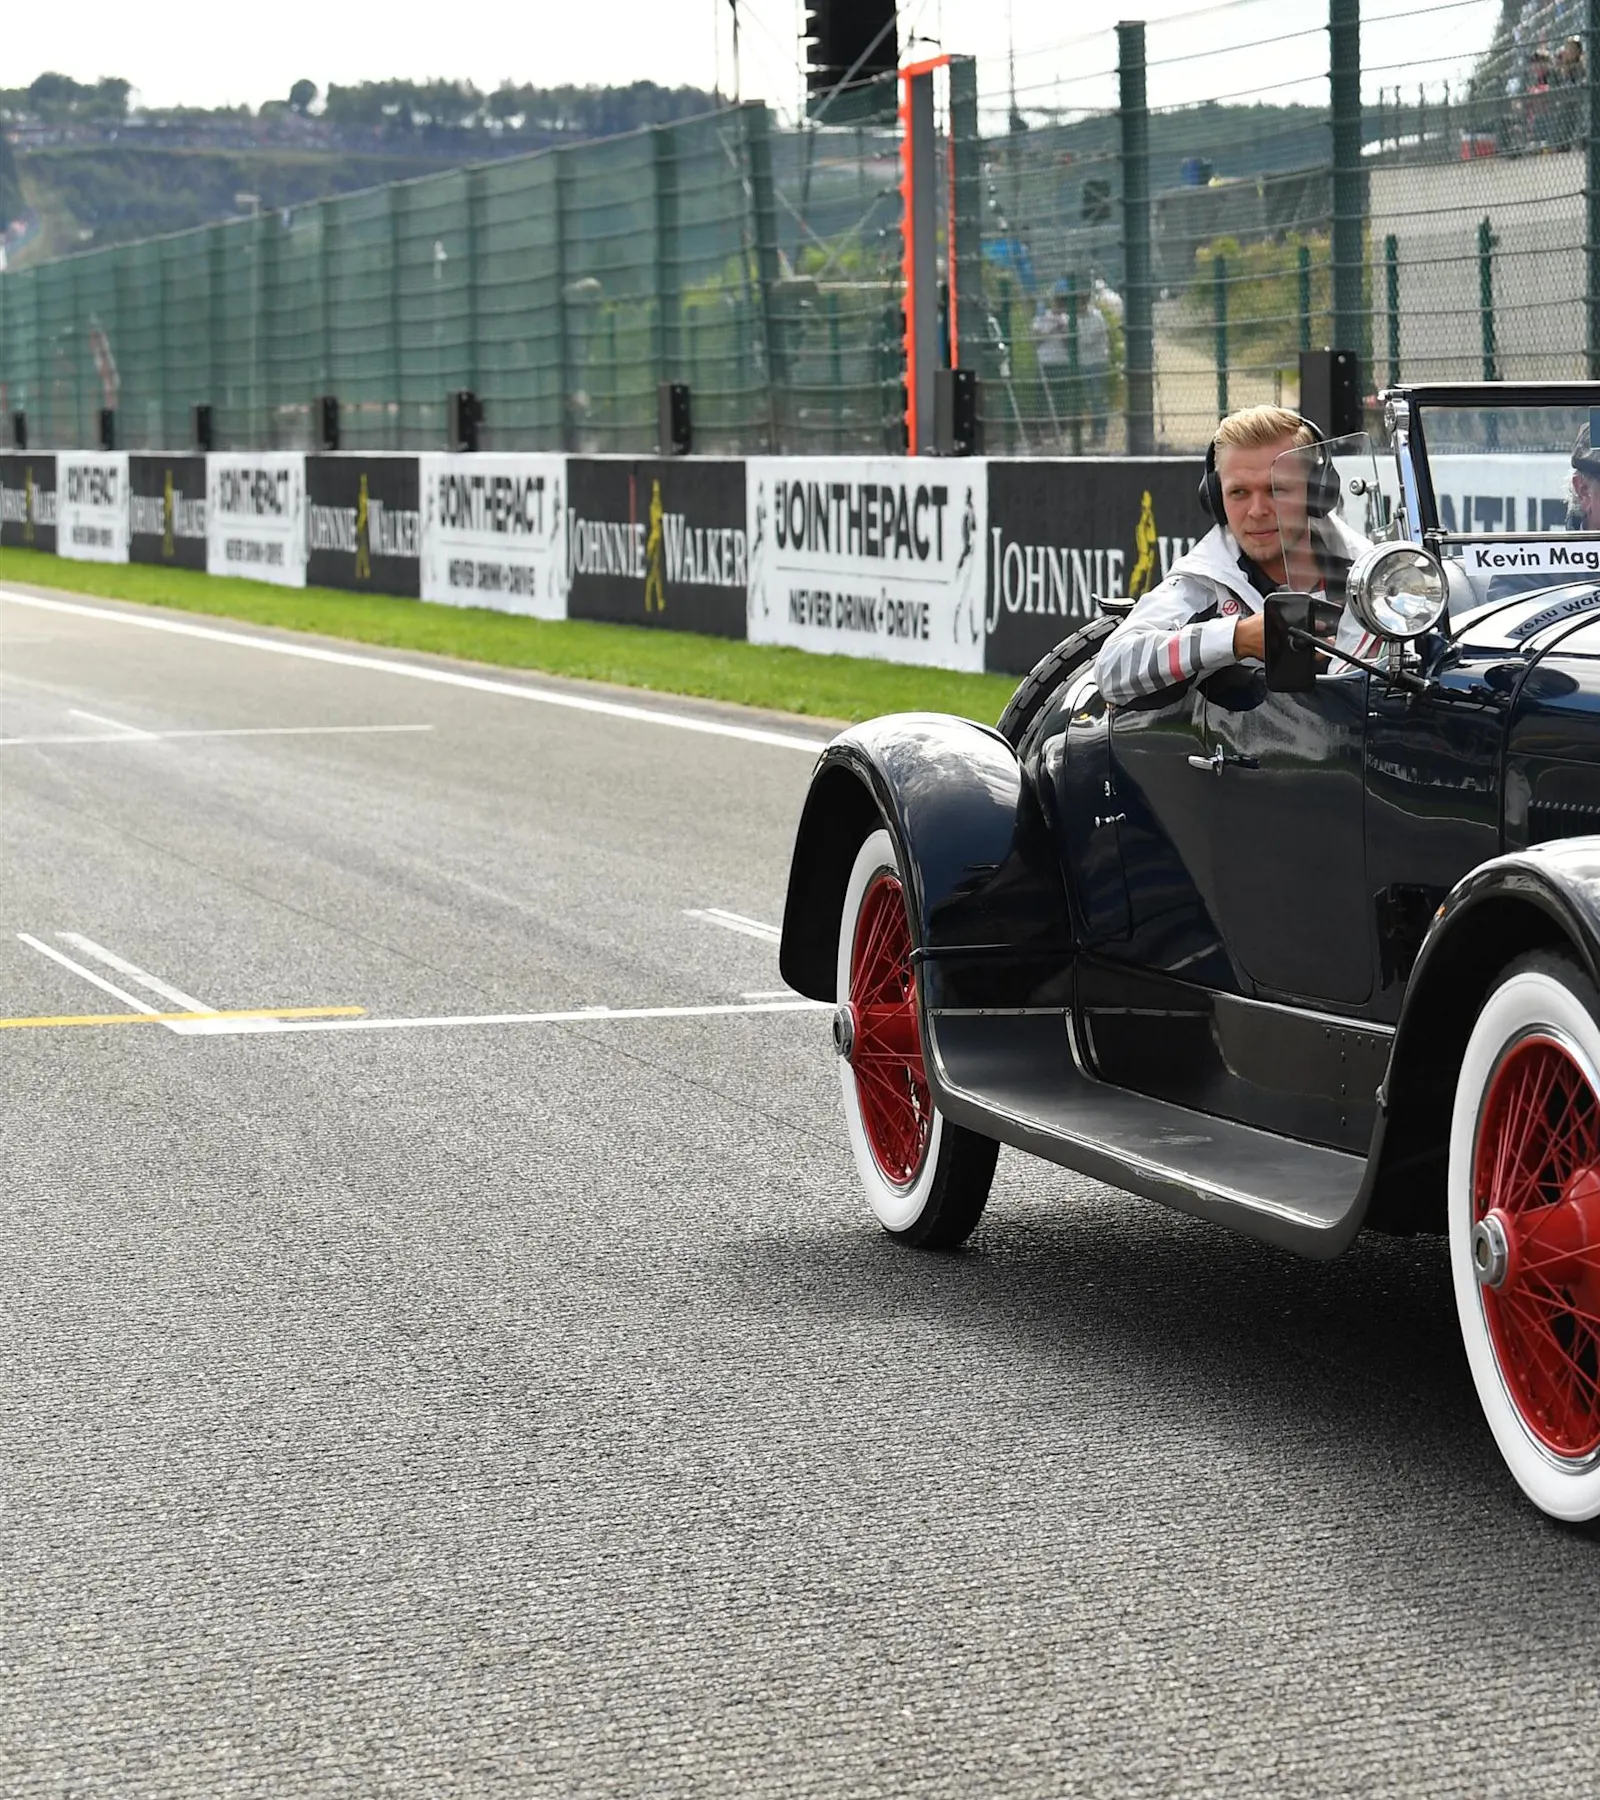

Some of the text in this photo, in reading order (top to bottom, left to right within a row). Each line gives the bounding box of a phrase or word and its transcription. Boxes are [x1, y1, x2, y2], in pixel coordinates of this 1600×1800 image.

[564, 507, 748, 594] JOHNNIE WALKER
[775, 480, 948, 562] #JOINTHEPACT
[1475, 547, 1541, 568] Kevin
[789, 589, 832, 628] NEVER
[986, 527, 1125, 635] JOHNNIE
